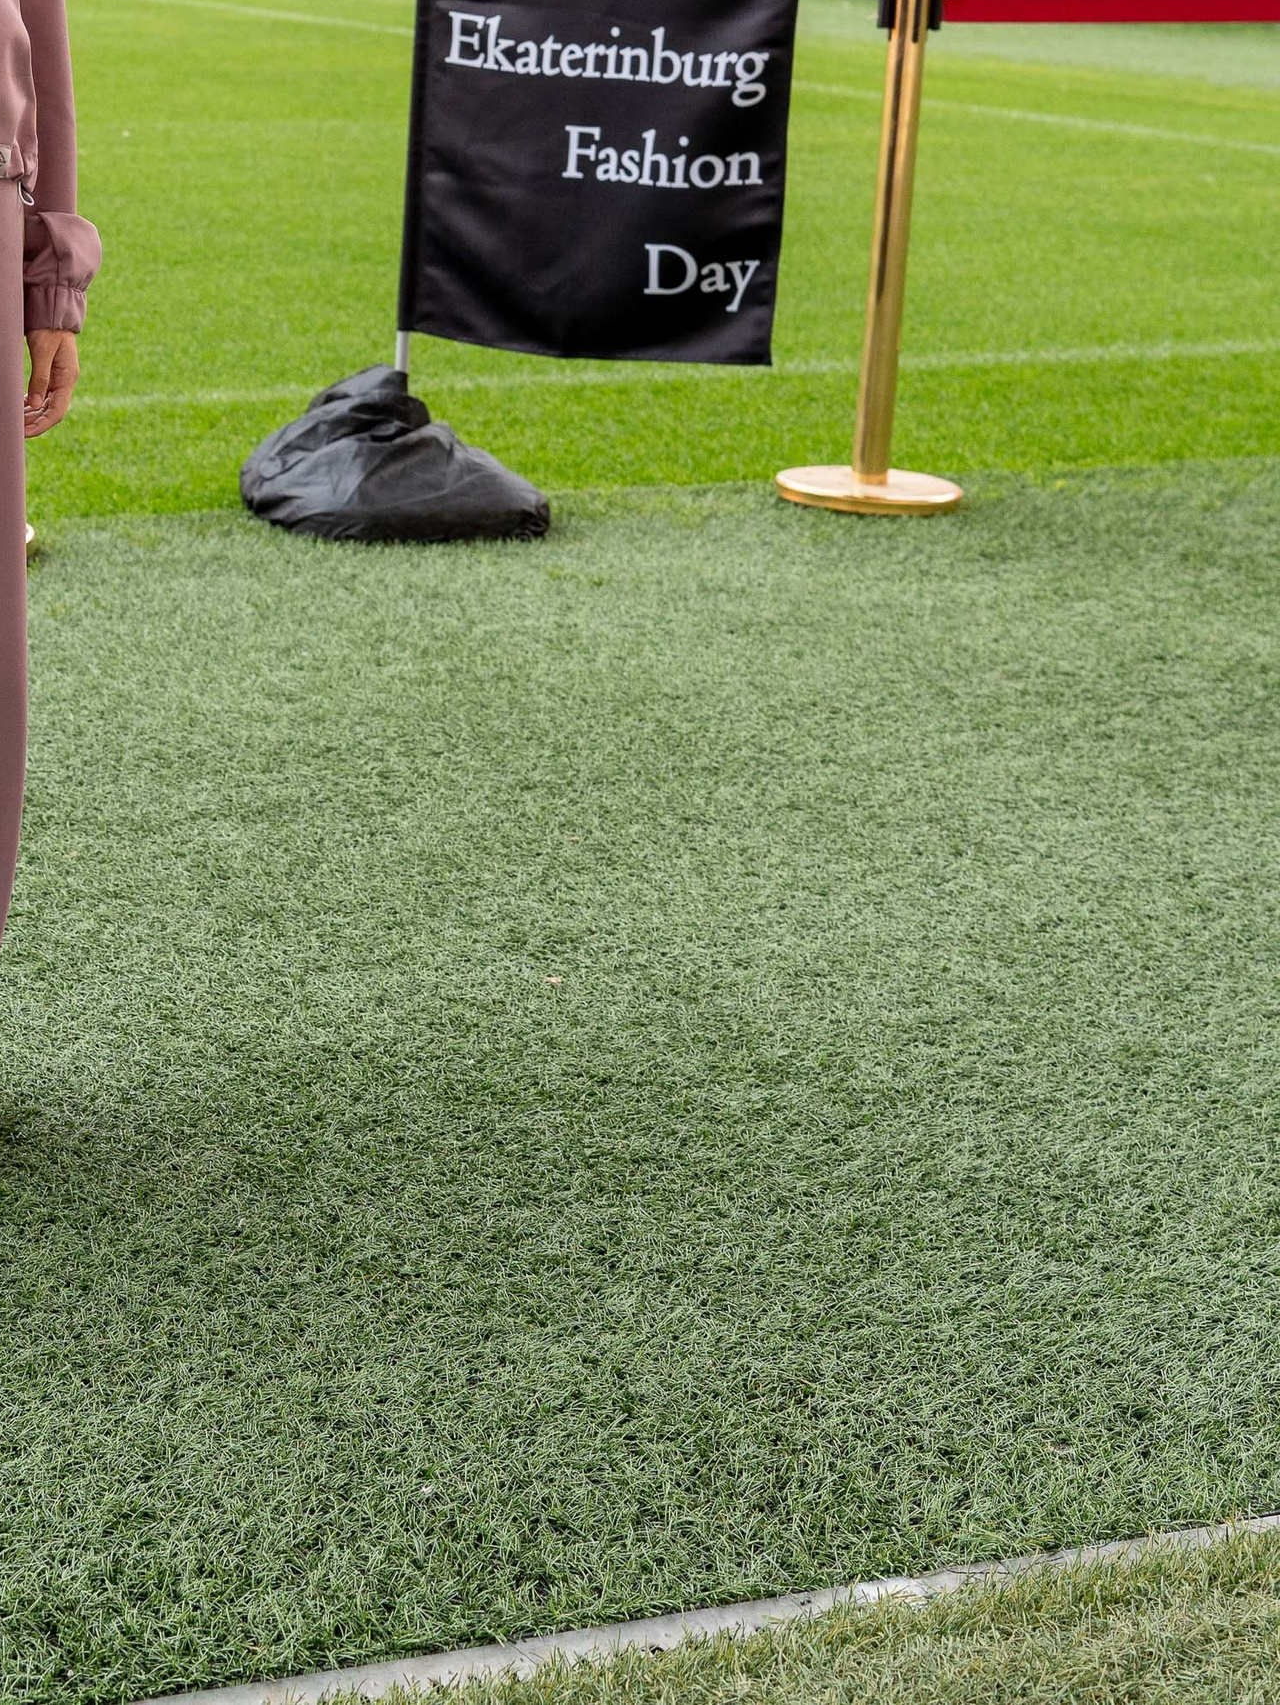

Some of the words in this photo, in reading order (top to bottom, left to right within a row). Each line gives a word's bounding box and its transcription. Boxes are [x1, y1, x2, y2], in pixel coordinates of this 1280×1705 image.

[445, 11, 769, 107] Ekaterinburg
[562, 125, 763, 189] Fashion
[643, 243, 760, 312] Day
